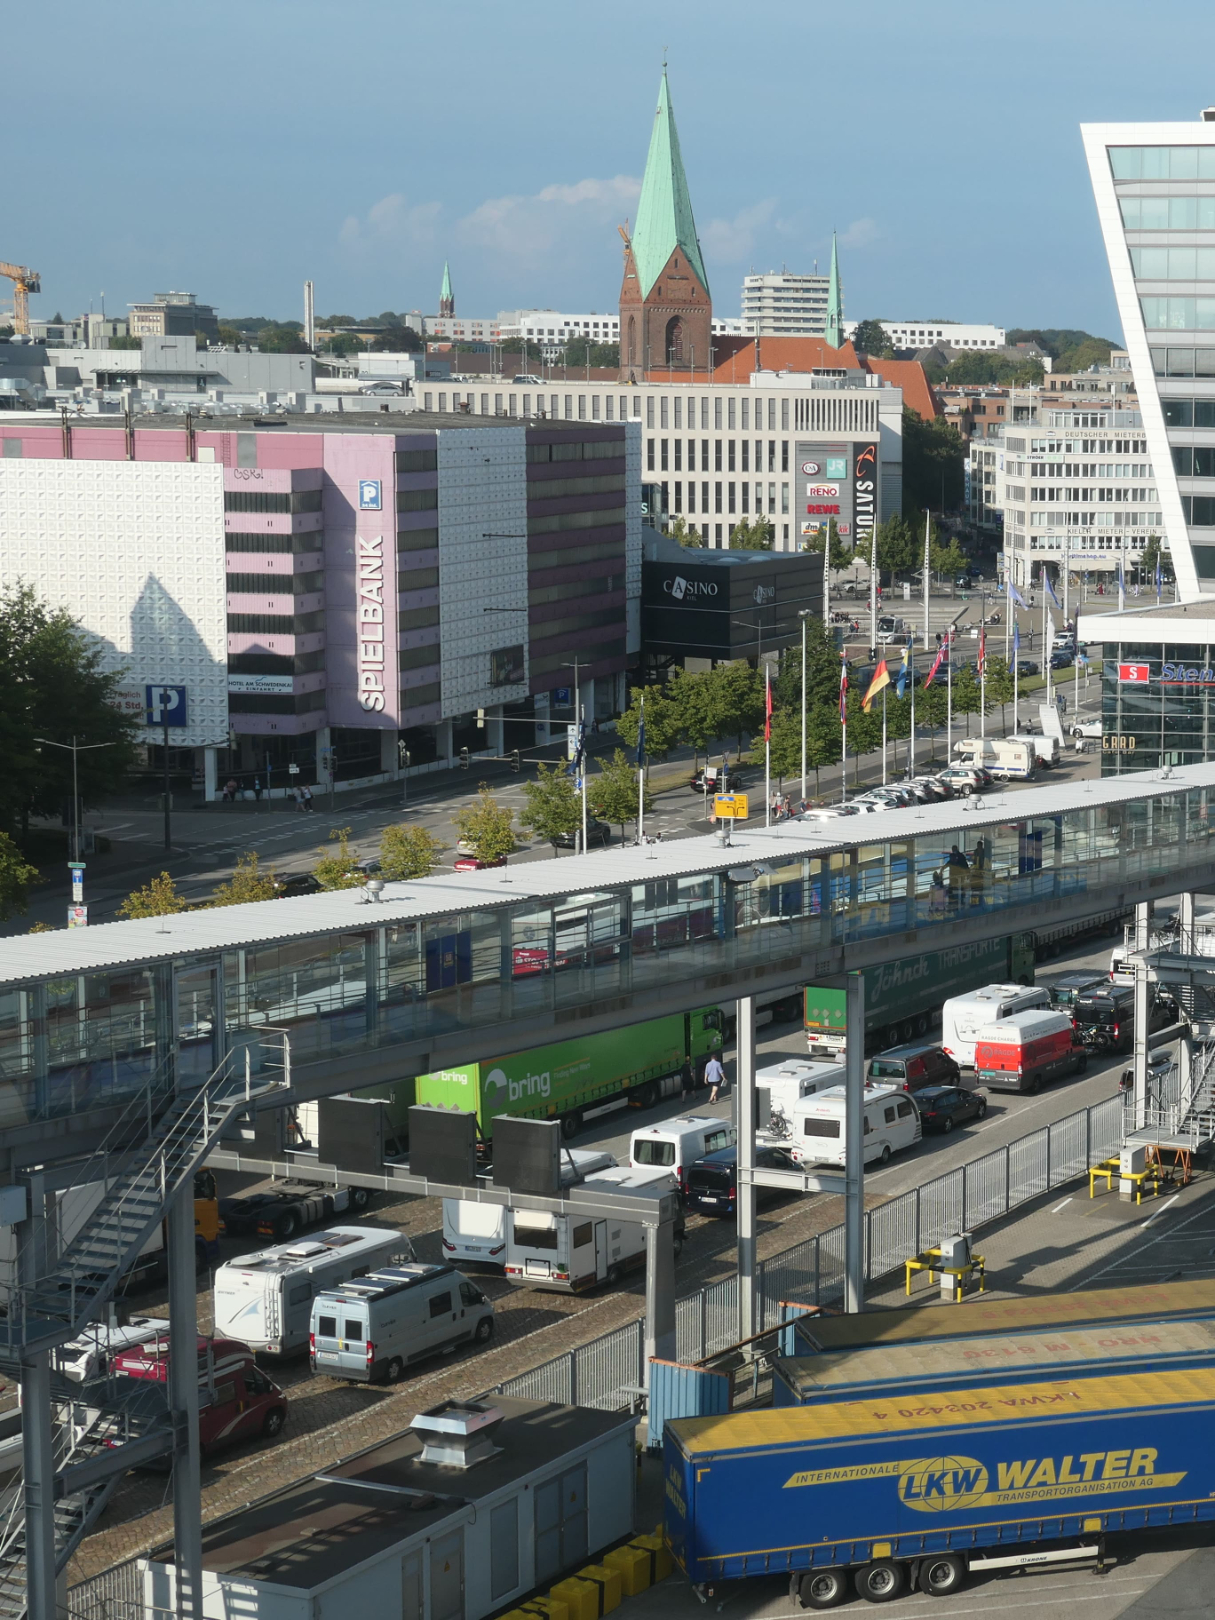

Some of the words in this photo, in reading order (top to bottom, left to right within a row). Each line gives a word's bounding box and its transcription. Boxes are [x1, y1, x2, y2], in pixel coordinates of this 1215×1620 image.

[828, 461, 844, 471] JR
[363, 486, 376, 502] P
[810, 488, 838, 496] RENO
[807, 504, 841, 515] REWE
[856, 480, 874, 546] SATUR
[663, 577, 718, 596] CASINO
[753, 585, 775, 600] CASINO
[359, 535, 385, 712] SPIELBANK
[152, 687, 179, 722] P
[1102, 736, 1136, 749] GRAD
[441, 1071, 468, 1085] bring
[509, 1071, 550, 1101] bring
[999, 1392, 1081, 1407] LKWA
[897, 1401, 993, 1419] 203420
[796, 1462, 900, 1485] INTERNATIONALE
[997, 1447, 1158, 1490] WALTER
[903, 1468, 984, 1500] LKW
[996, 1480, 1136, 1502] TRANSPORTORGANISATION
[1139, 1477, 1154, 1487] AG
